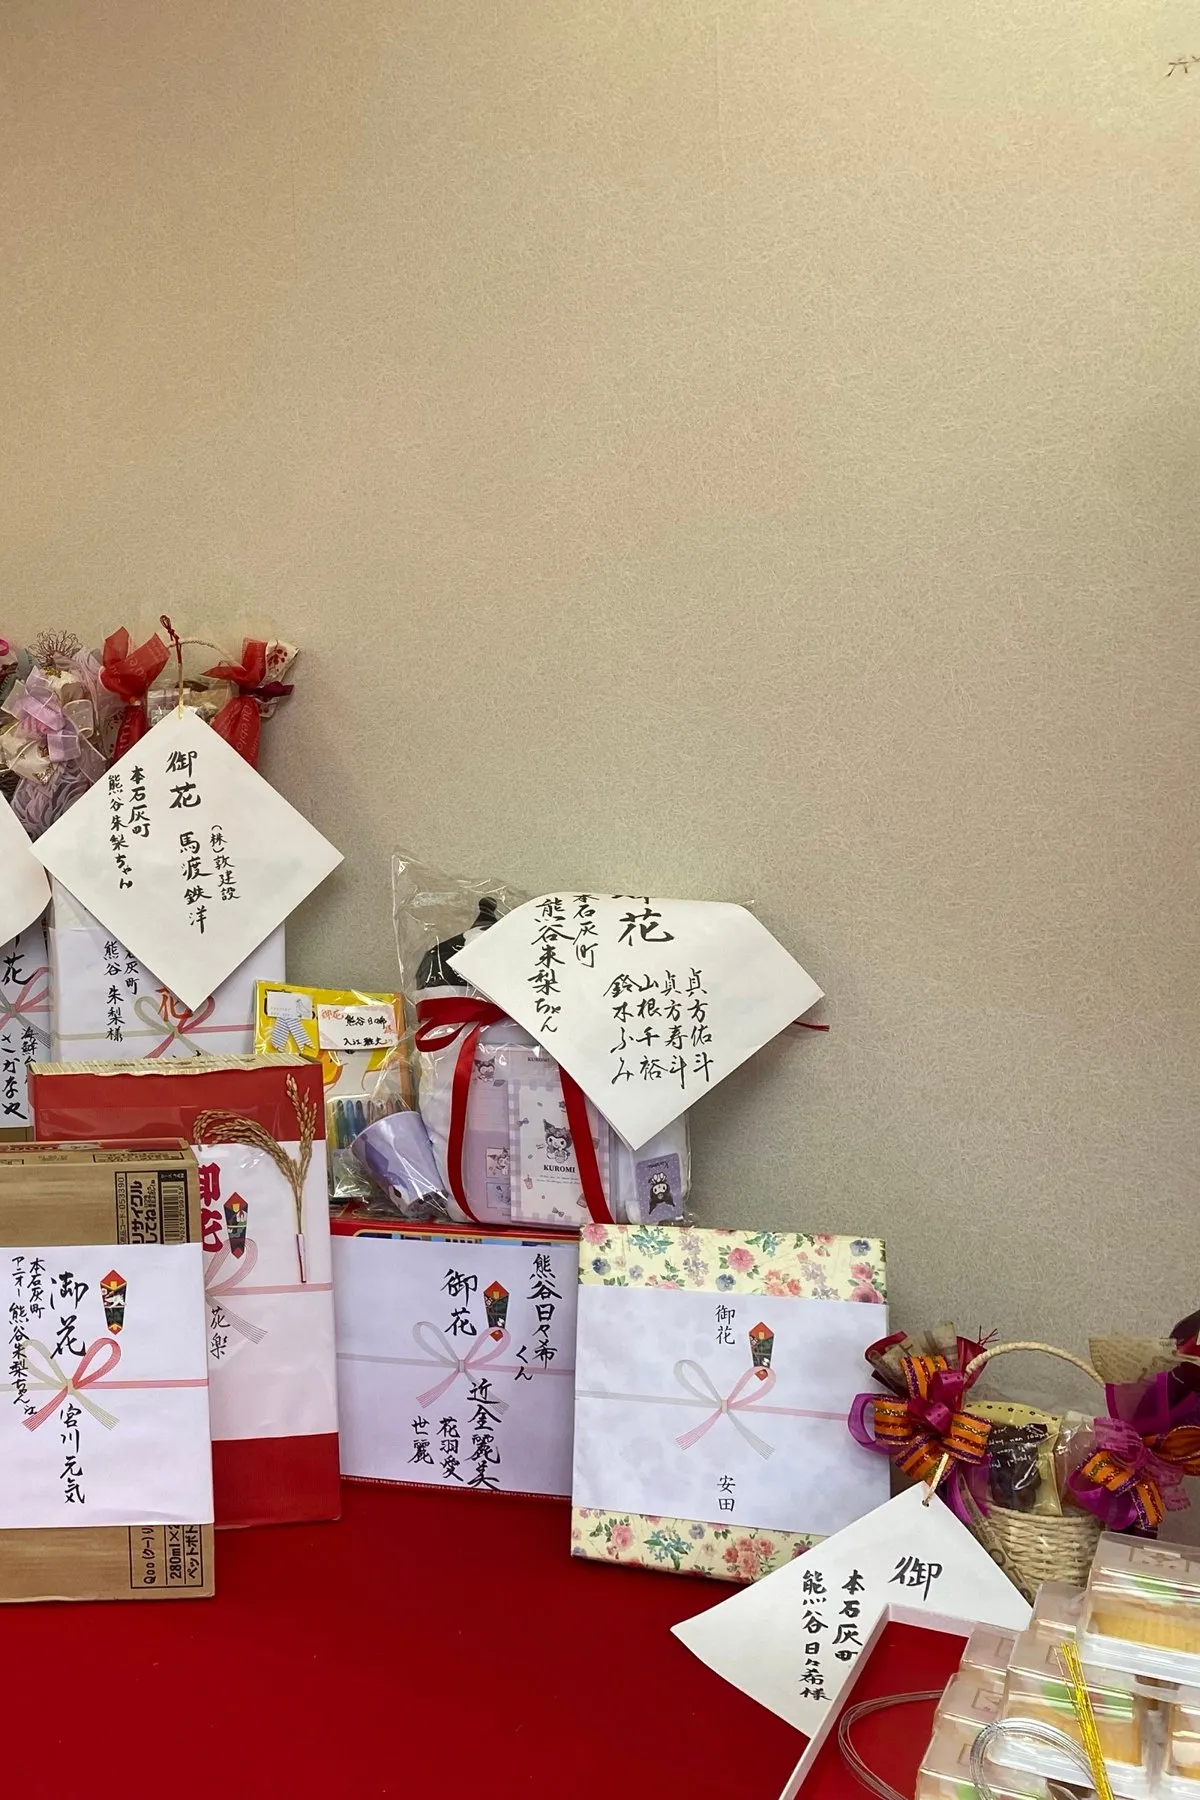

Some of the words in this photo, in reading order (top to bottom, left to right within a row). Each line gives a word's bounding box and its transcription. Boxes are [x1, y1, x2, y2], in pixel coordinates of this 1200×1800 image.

[128, 765, 151, 839] 本石灰町
[164, 750, 202, 810] 御花
[107, 774, 134, 890] 熊谷朱梨ちゃん
[179, 831, 214, 935] 馬渡鉄洋
[103, 940, 125, 1043] 熊谷朱梨様
[527, 897, 576, 1034] 熊谷朱梨ちゃん
[685, 967, 715, 1083] 貞方佑斗
[543, 1164, 576, 1174] KUROMI
[27, 1257, 47, 1320] 本石灰町
[49, 1272, 91, 1360] 御花
[440, 1267, 479, 1337] 御花
[526, 1252, 564, 1370] 熊谷日々希
[715, 1303, 736, 1346] 御花
[514, 1344, 534, 1382] くん
[59, 1402, 87, 1505] 宮川元気
[716, 1474, 737, 1513] 安田
[888, 1555, 943, 1602] 御
